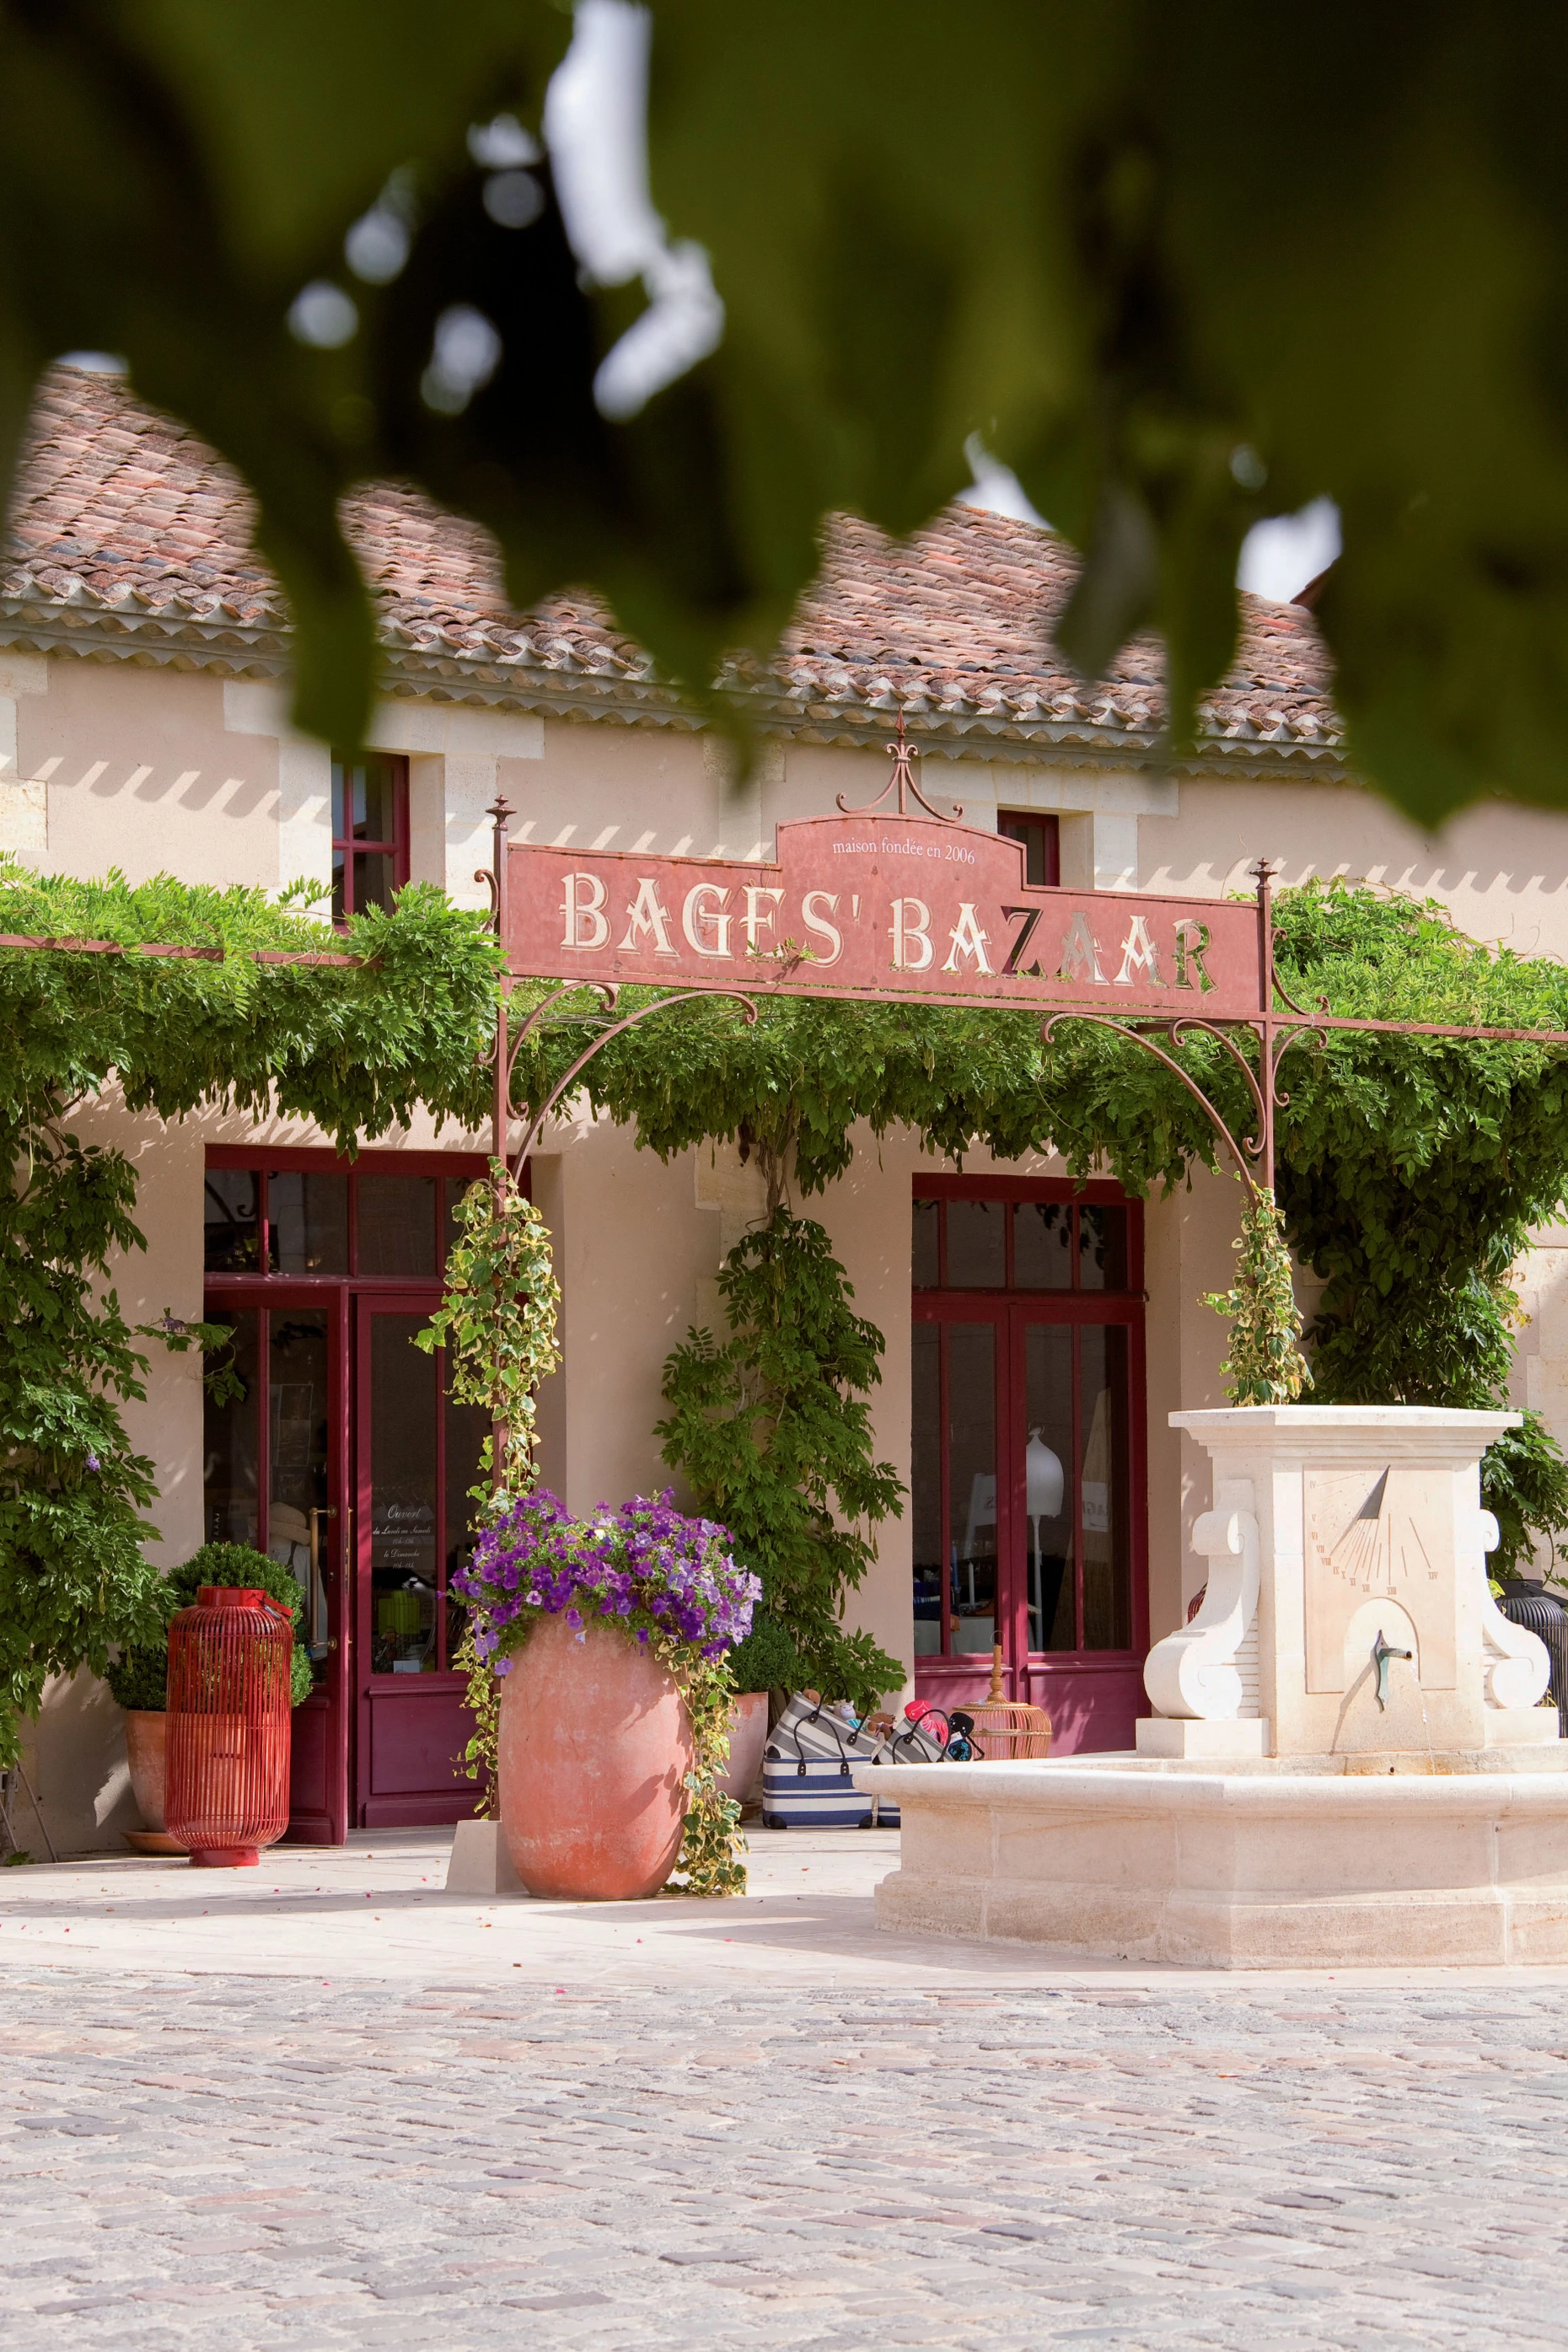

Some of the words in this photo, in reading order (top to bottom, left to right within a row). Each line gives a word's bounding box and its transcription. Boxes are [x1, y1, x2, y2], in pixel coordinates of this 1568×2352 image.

[832, 837, 878, 853] maison
[881, 836, 923, 856] fondée
[926, 846, 942, 858] en
[944, 844, 975, 865] 2006
[559, 872, 862, 969] BAGES'
[887, 897, 1219, 994] BAZAAR
[388, 1503, 422, 1518] Ouvert
[381, 1525, 401, 1534] Lundi
[410, 1525, 432, 1534] Samedi
[390, 1549, 421, 1558] Dimanche
